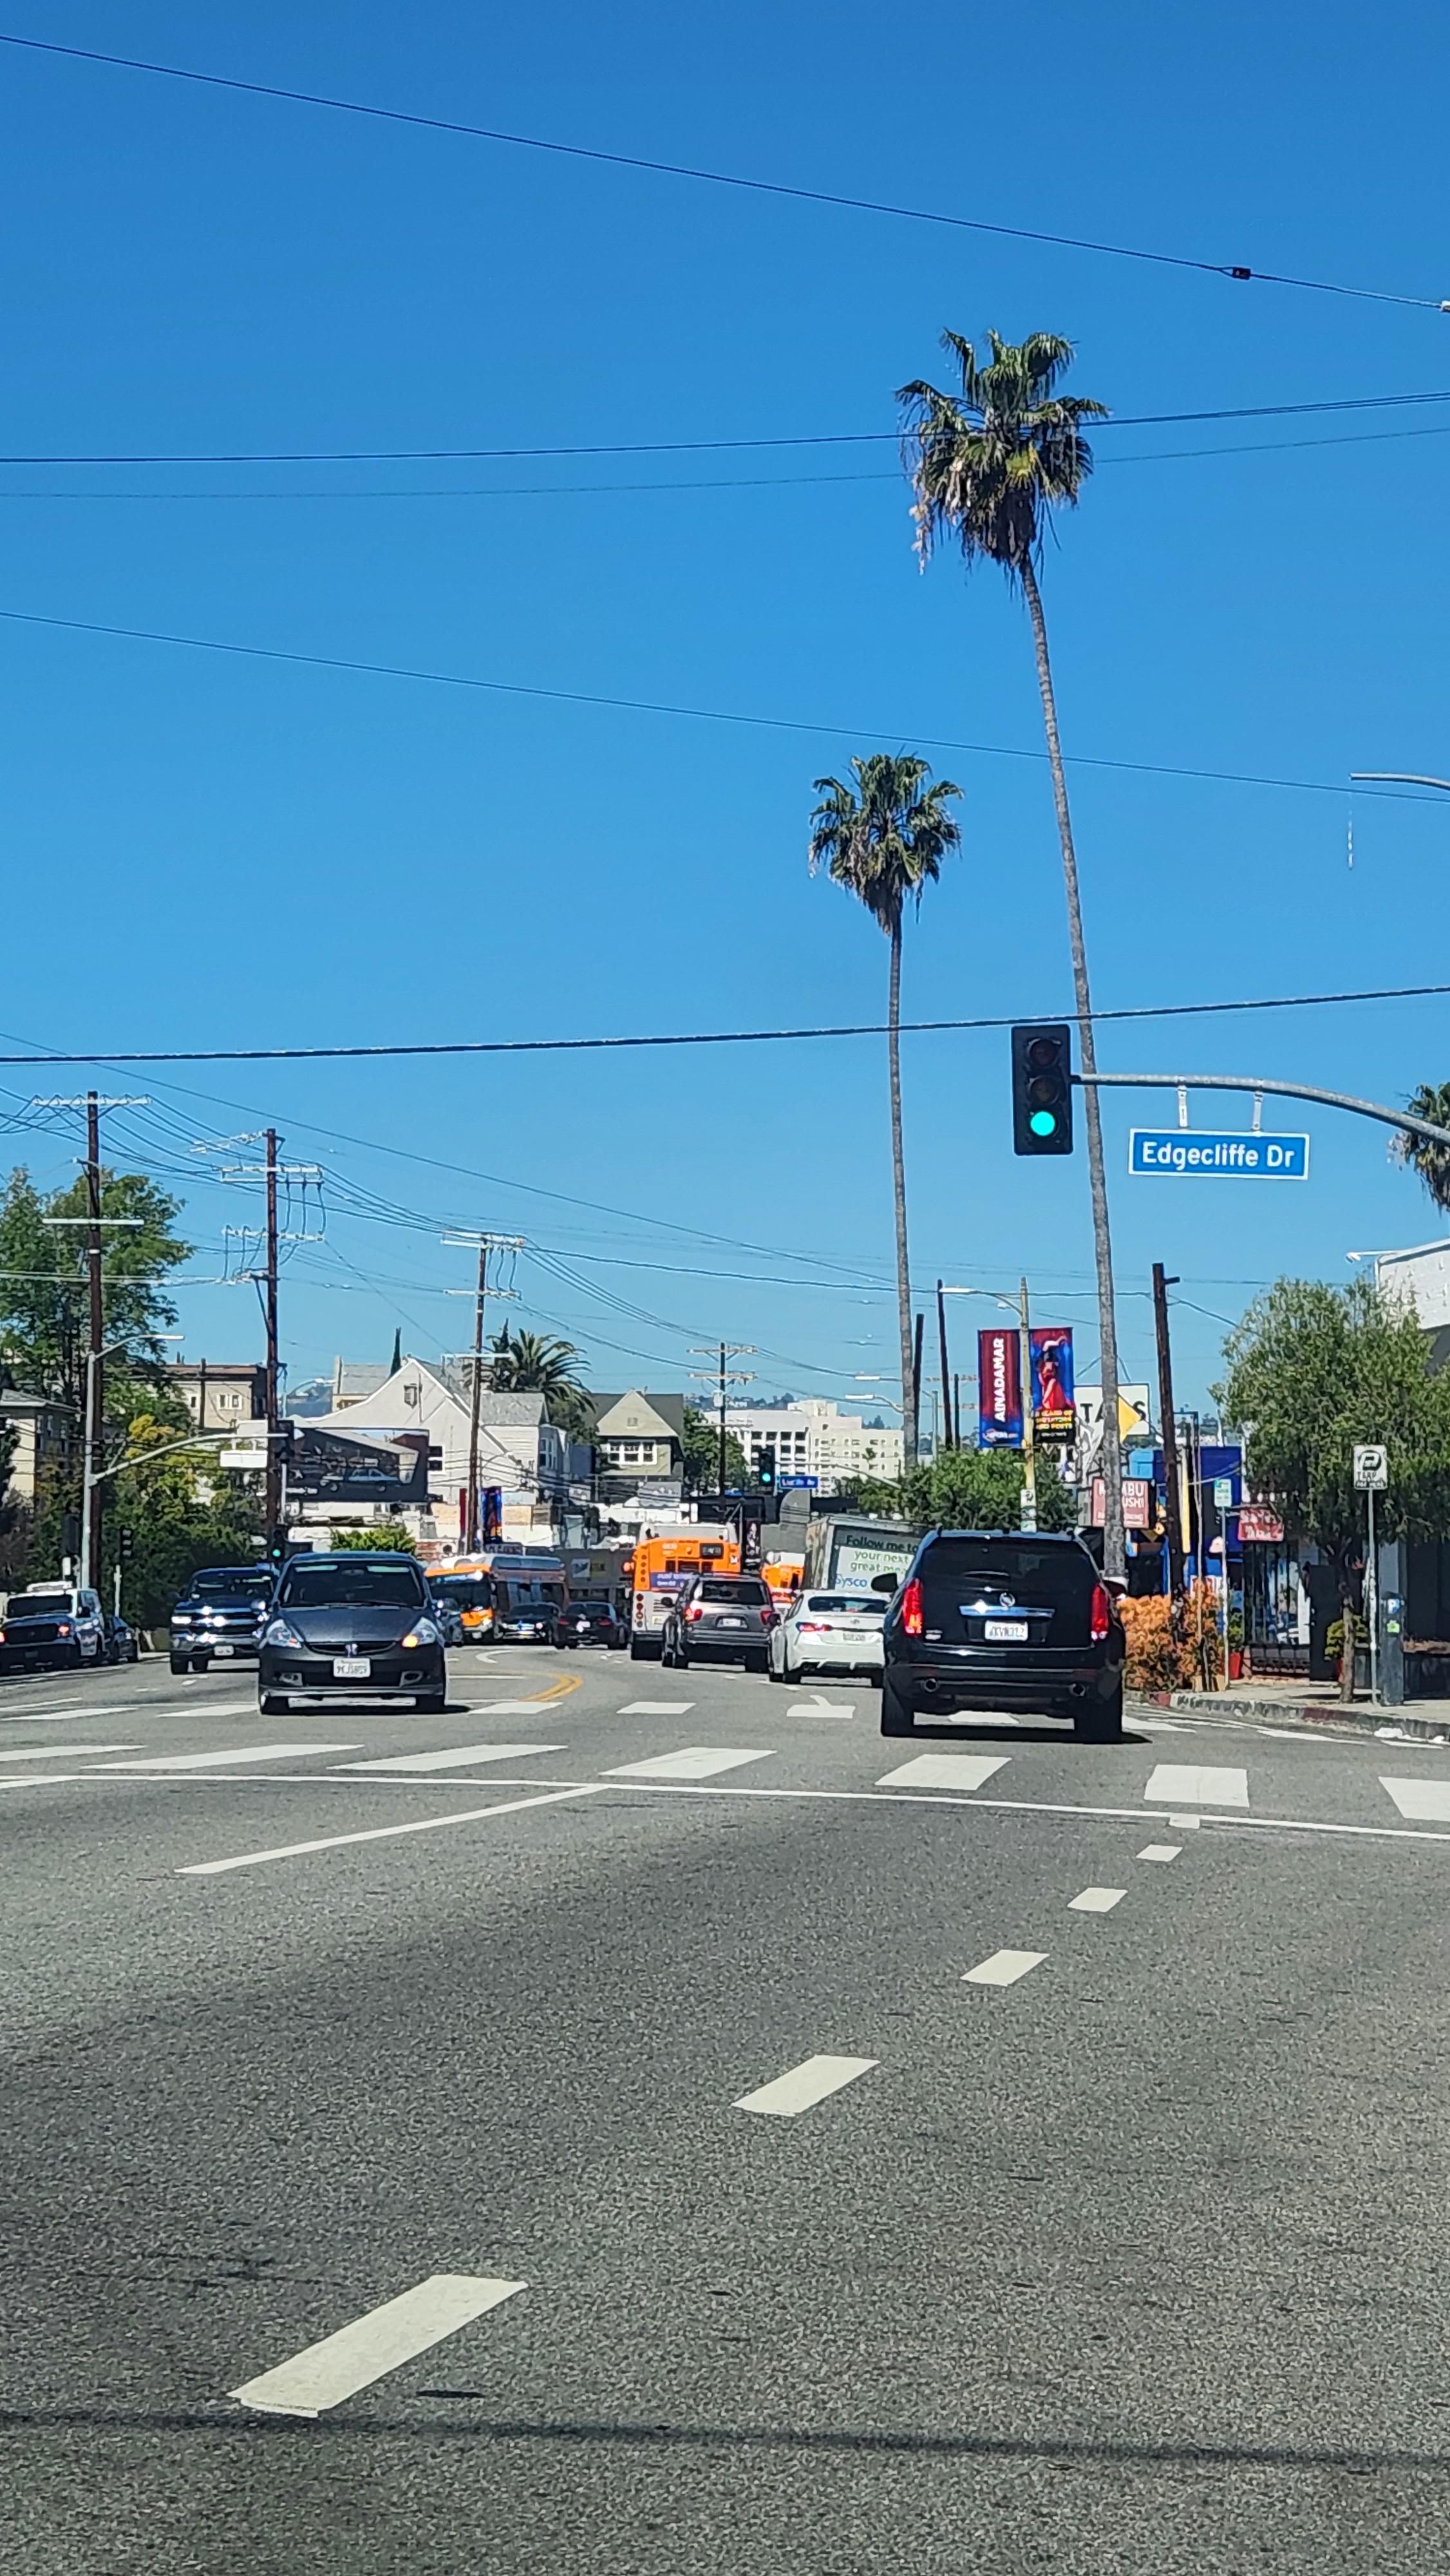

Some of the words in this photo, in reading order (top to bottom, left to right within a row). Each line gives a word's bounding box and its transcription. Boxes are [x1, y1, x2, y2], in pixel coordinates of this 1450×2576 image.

[1142, 1141, 1259, 1171] Edgecliffe
[1266, 1144, 1295, 1168] Dr
[993, 1337, 1006, 1423] AINADAMAR
[1122, 1497, 1144, 1508] USHI
[846, 1535, 884, 1547] Follow
[886, 1541, 904, 1550] me
[907, 1542, 919, 1553] to
[854, 1550, 881, 1560] your
[883, 1553, 909, 1564] next
[851, 1562, 881, 1572] great
